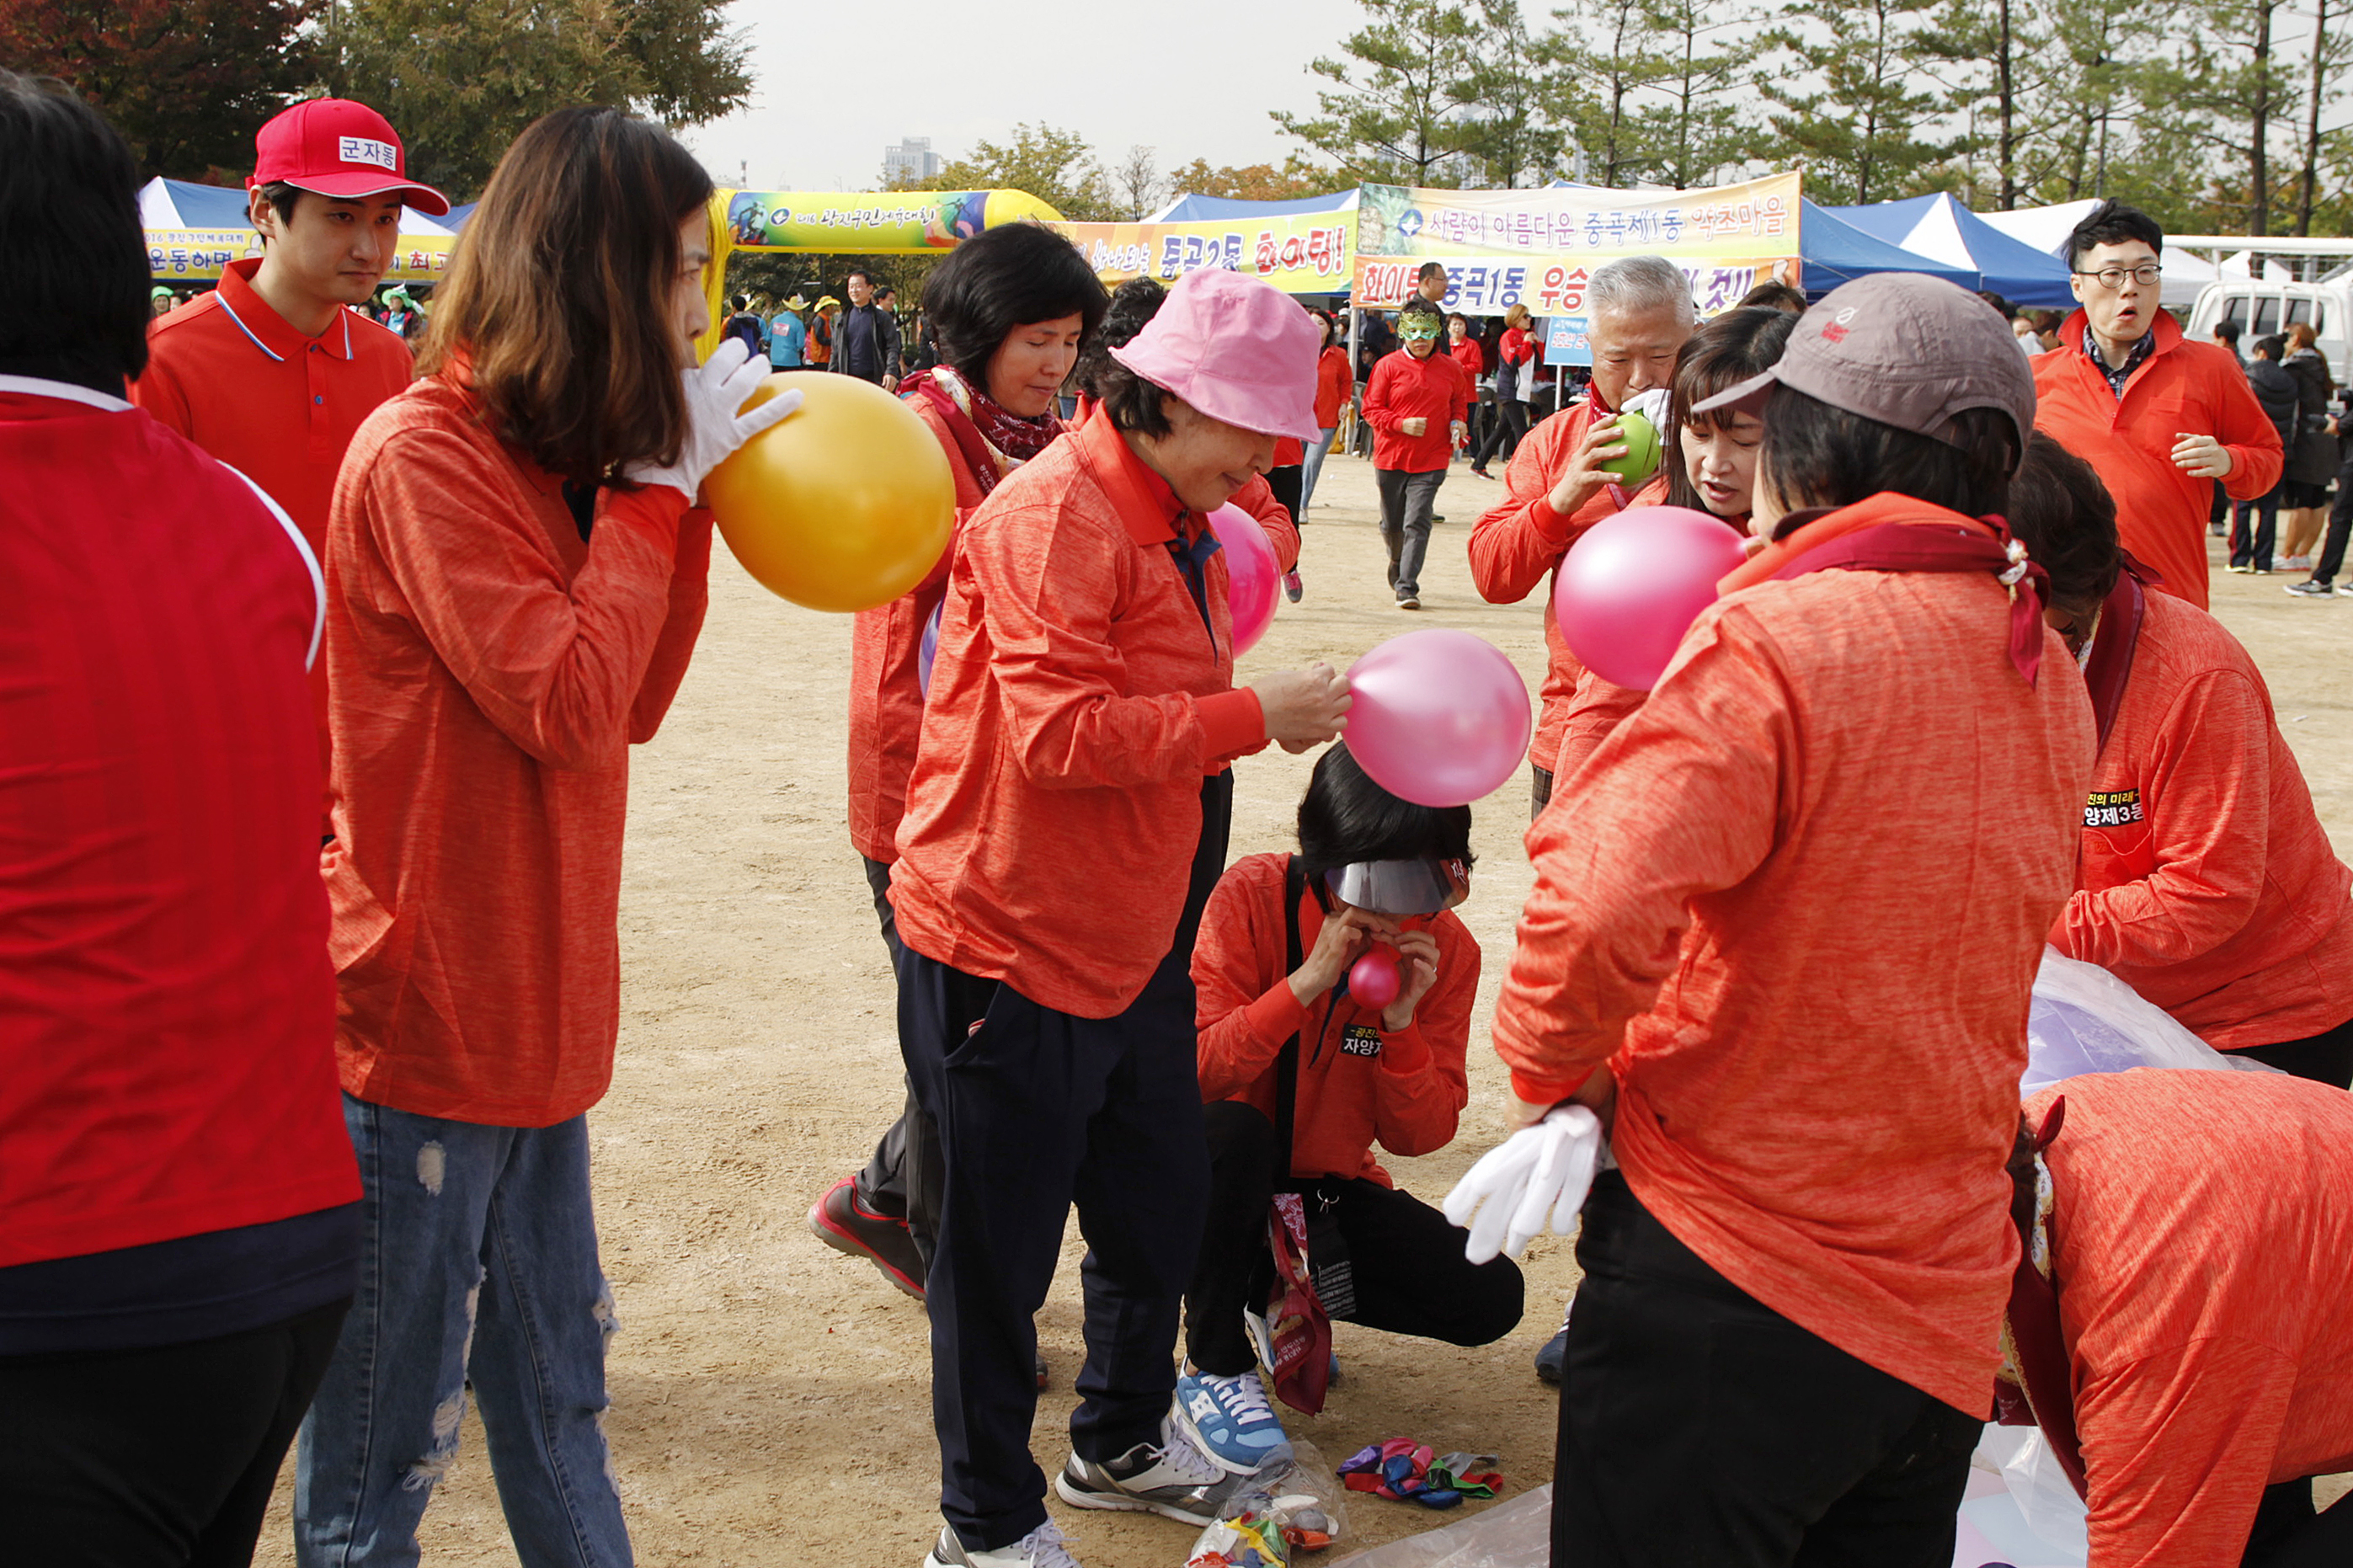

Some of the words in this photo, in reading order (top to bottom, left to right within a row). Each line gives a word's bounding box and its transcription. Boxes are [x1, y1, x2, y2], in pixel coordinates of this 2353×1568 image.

[342, 139, 394, 168] 군자동
[819, 207, 935, 230] 광진구민체육대회
[1429, 210, 1486, 244] 사람이
[1493, 211, 1576, 247] 아름다운
[1584, 209, 1684, 247] 중곡제1동
[1690, 195, 1789, 240] 약초마을
[1255, 227, 1347, 275] 화이팅!
[1440, 266, 1527, 308] 중곡1동
[2081, 803, 2144, 826] 양제3동
